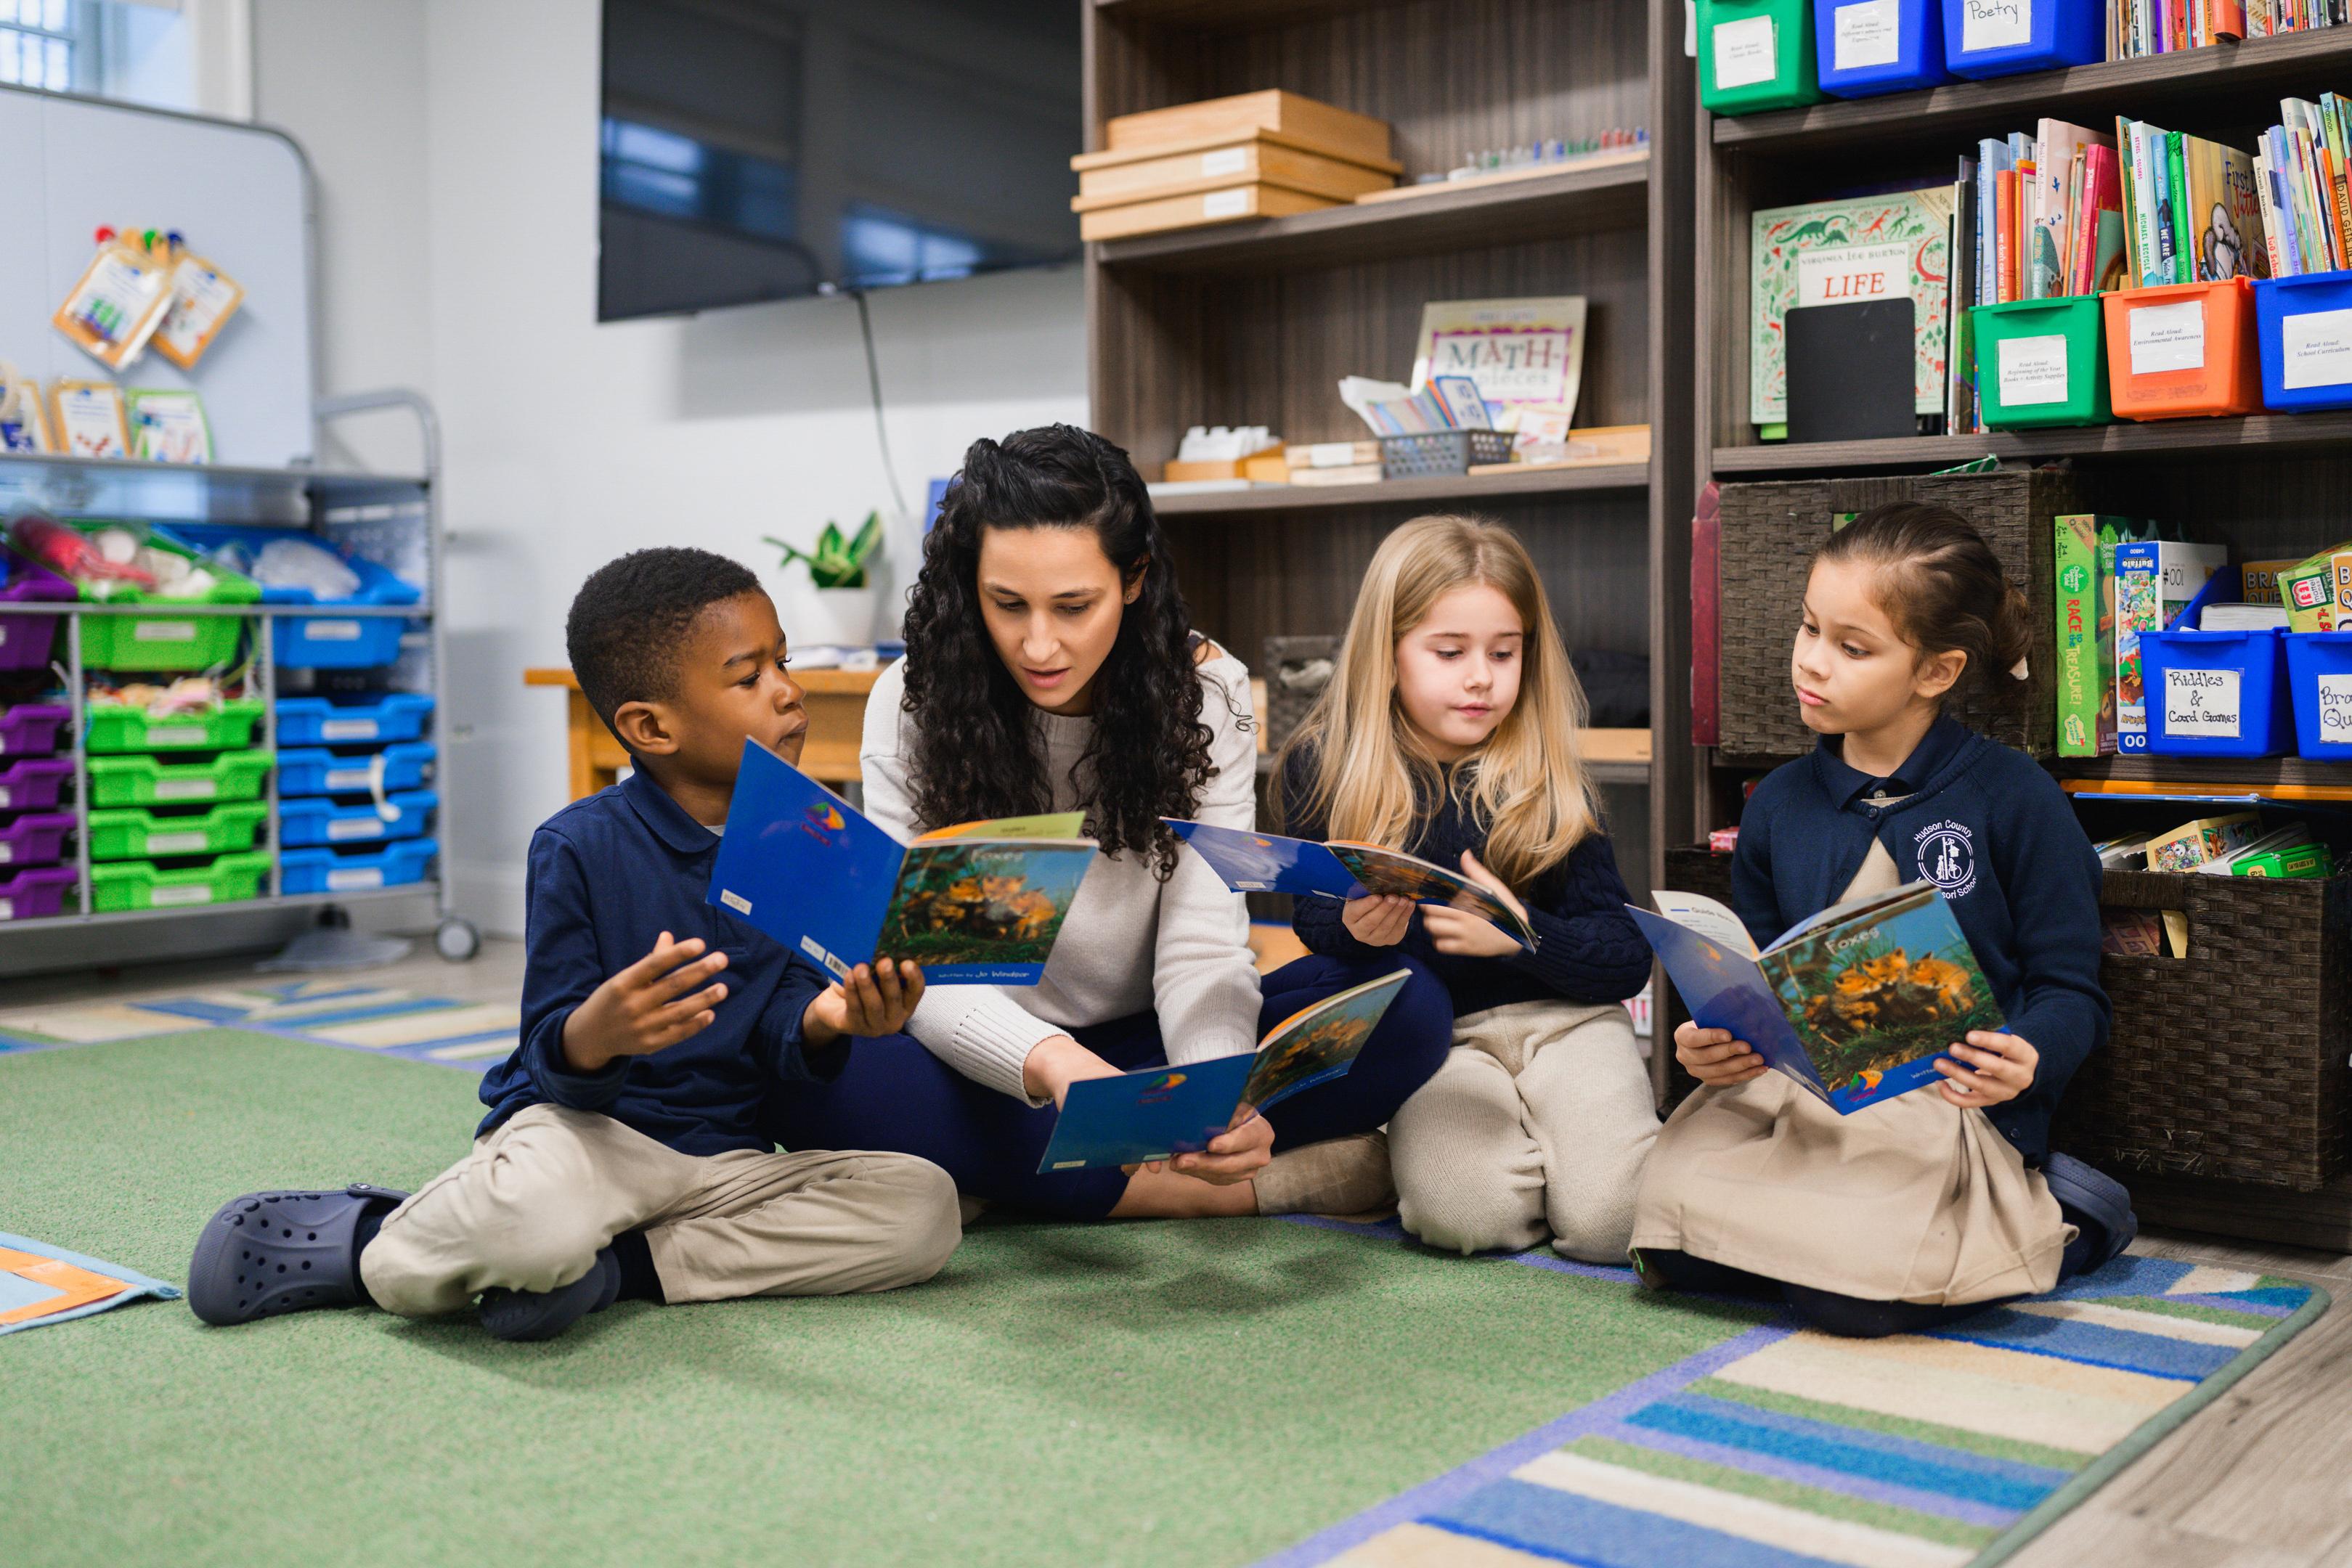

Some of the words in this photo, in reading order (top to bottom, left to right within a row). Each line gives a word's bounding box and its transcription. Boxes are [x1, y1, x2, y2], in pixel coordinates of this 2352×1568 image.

[1966, 0, 2018, 24] Poetry
[2324, 102, 2333, 132] Shannon
[2225, 161, 2248, 189] First
[2337, 186, 2348, 216] DAVID
[1998, 233, 2004, 243] we
[2160, 229, 2168, 241] WE
[1802, 254, 1843, 266] VIRGINIA
[1868, 248, 1906, 260] BURTON
[2142, 242, 2151, 271] RECYCLE
[1824, 272, 1886, 298] LIFE
[2133, 337, 2172, 346] Environmental
[2122, 559, 2154, 568] Buffalo
[2247, 592, 2282, 605] QUE
[2309, 579, 2320, 603] mattel
[2067, 599, 2083, 634] RACE
[2076, 634, 2083, 643] to
[2065, 645, 2083, 705] TREASURE!
[2169, 671, 2223, 687] Riddles
[2190, 690, 2203, 706] &
[2168, 710, 2198, 722] Card
[2202, 709, 2237, 723] Games
[1913, 822, 1942, 842] Hudson
[1945, 819, 1973, 838] Country
[1824, 926, 1881, 956] Foxes
